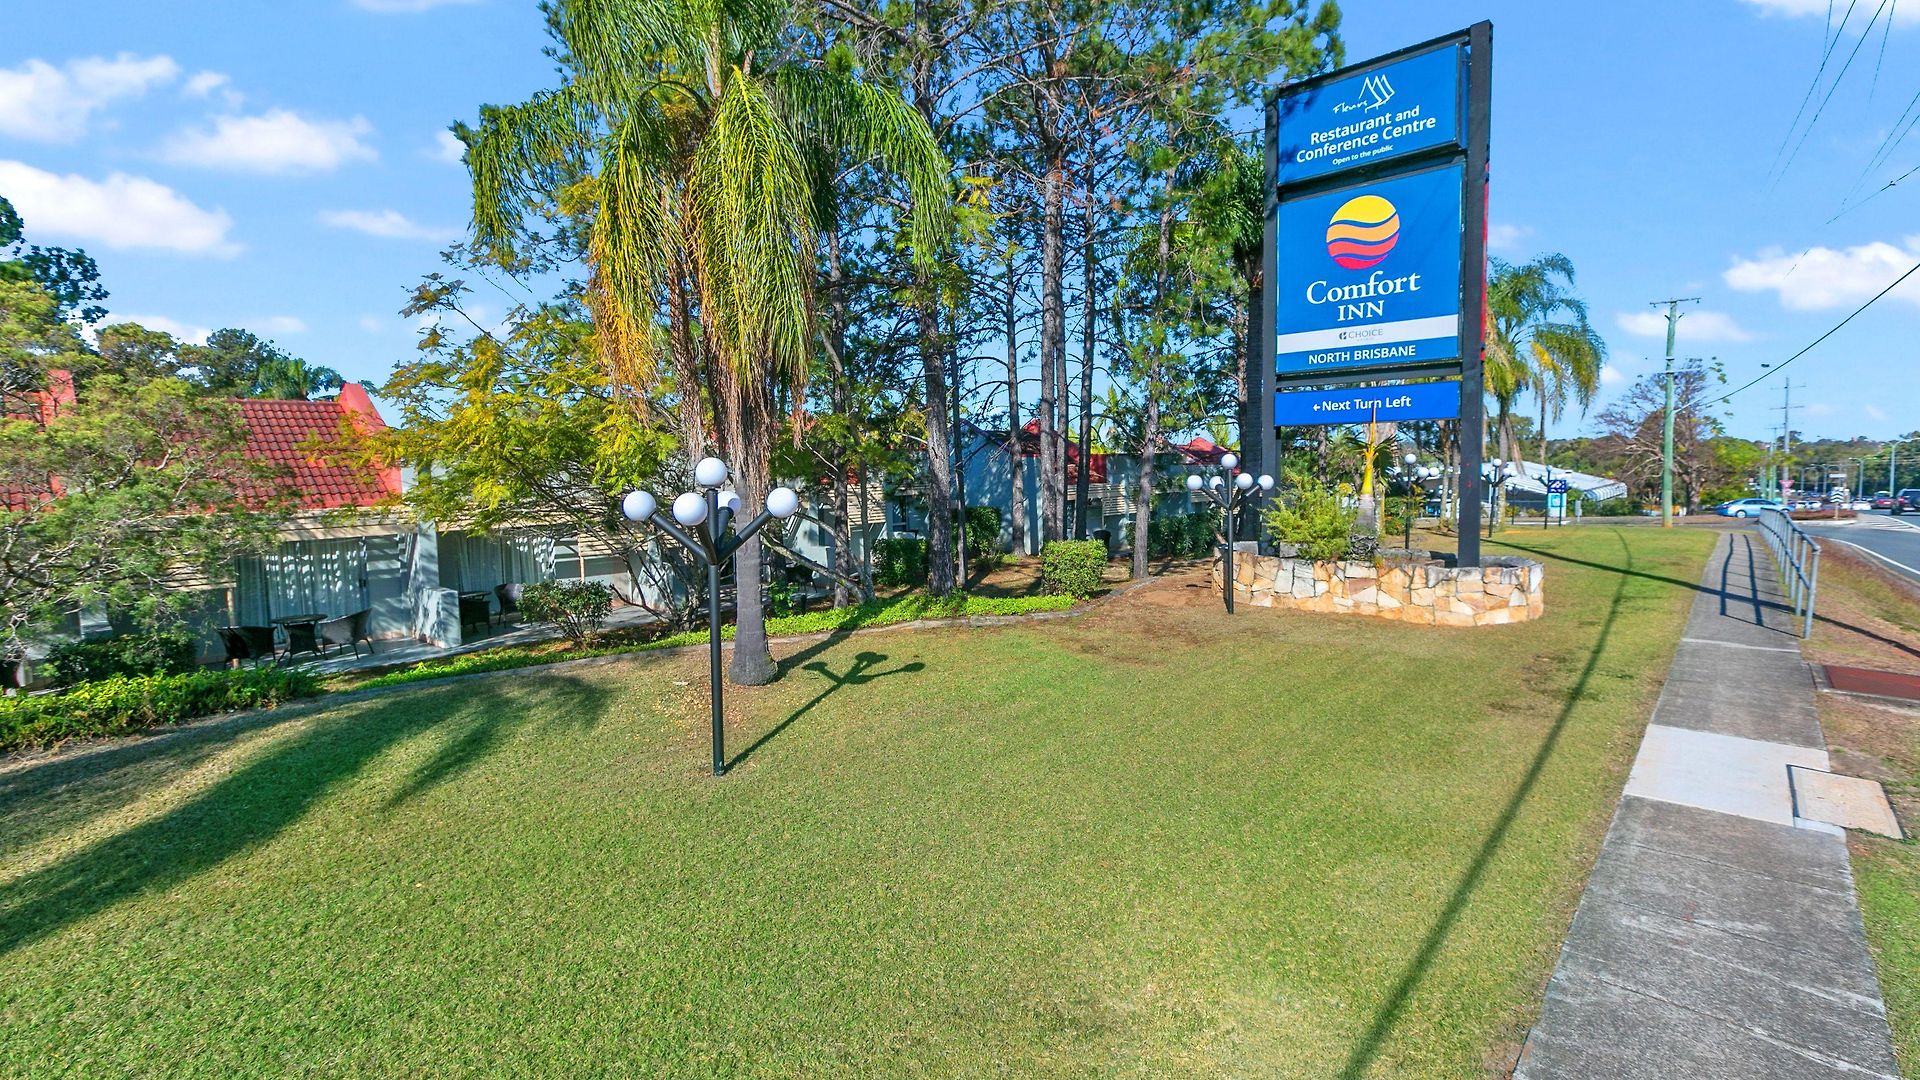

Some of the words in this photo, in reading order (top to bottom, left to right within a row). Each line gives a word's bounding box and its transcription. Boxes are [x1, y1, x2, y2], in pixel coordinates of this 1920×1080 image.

[1310, 112, 1391, 145] Restaurant
[1395, 105, 1420, 121] and
[1297, 133, 1379, 163] Conference
[1383, 117, 1436, 140] Centre
[1333, 156, 1349, 165] Open
[1360, 150, 1371, 158] the
[1373, 145, 1393, 156] public
[1307, 271, 1420, 304] Comfort
[1337, 300, 1384, 321] INN
[1348, 329, 1383, 338] CHOICE
[1309, 351, 1350, 364] NORTH
[1354, 345, 1416, 360] BRISBANE
[1322, 400, 1350, 411] Next
[1354, 398, 1381, 409] Turn
[1386, 396, 1411, 408] Left
